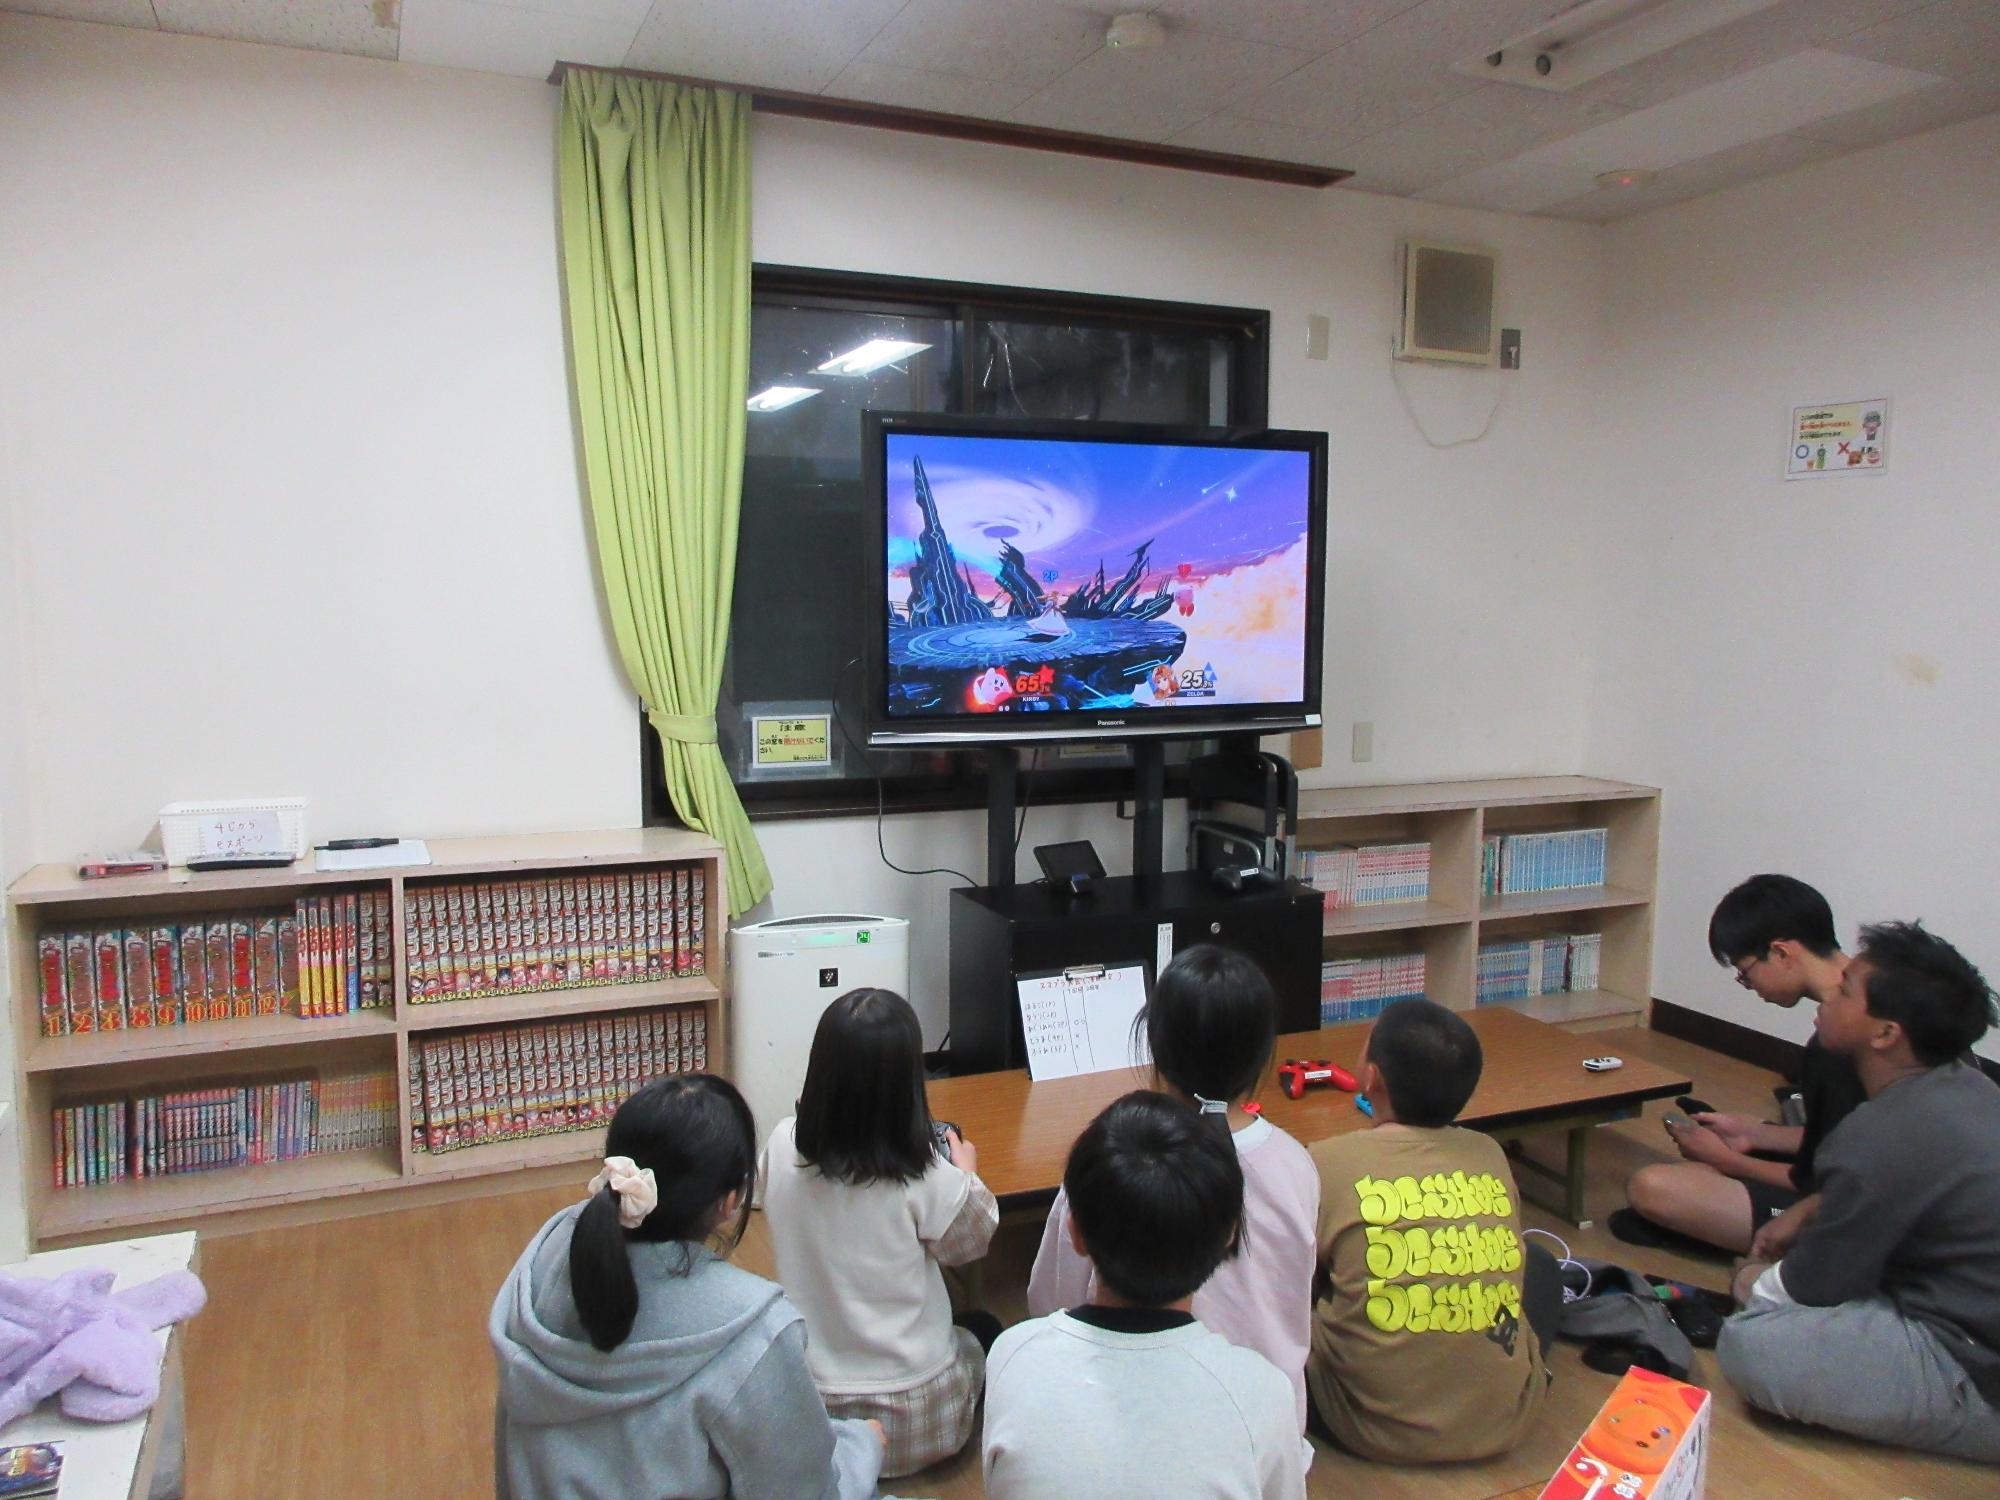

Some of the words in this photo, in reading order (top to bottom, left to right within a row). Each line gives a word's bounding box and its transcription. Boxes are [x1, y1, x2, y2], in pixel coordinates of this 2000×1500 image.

[132, 1006, 152, 1027] 8
[157, 1006, 176, 1025] 9
[186, 1003, 207, 1023] 10
[209, 1001, 231, 1021] 10
[235, 999, 251, 1018] 11
[48, 1015, 60, 1036] 1
[73, 1014, 94, 1034] 2
